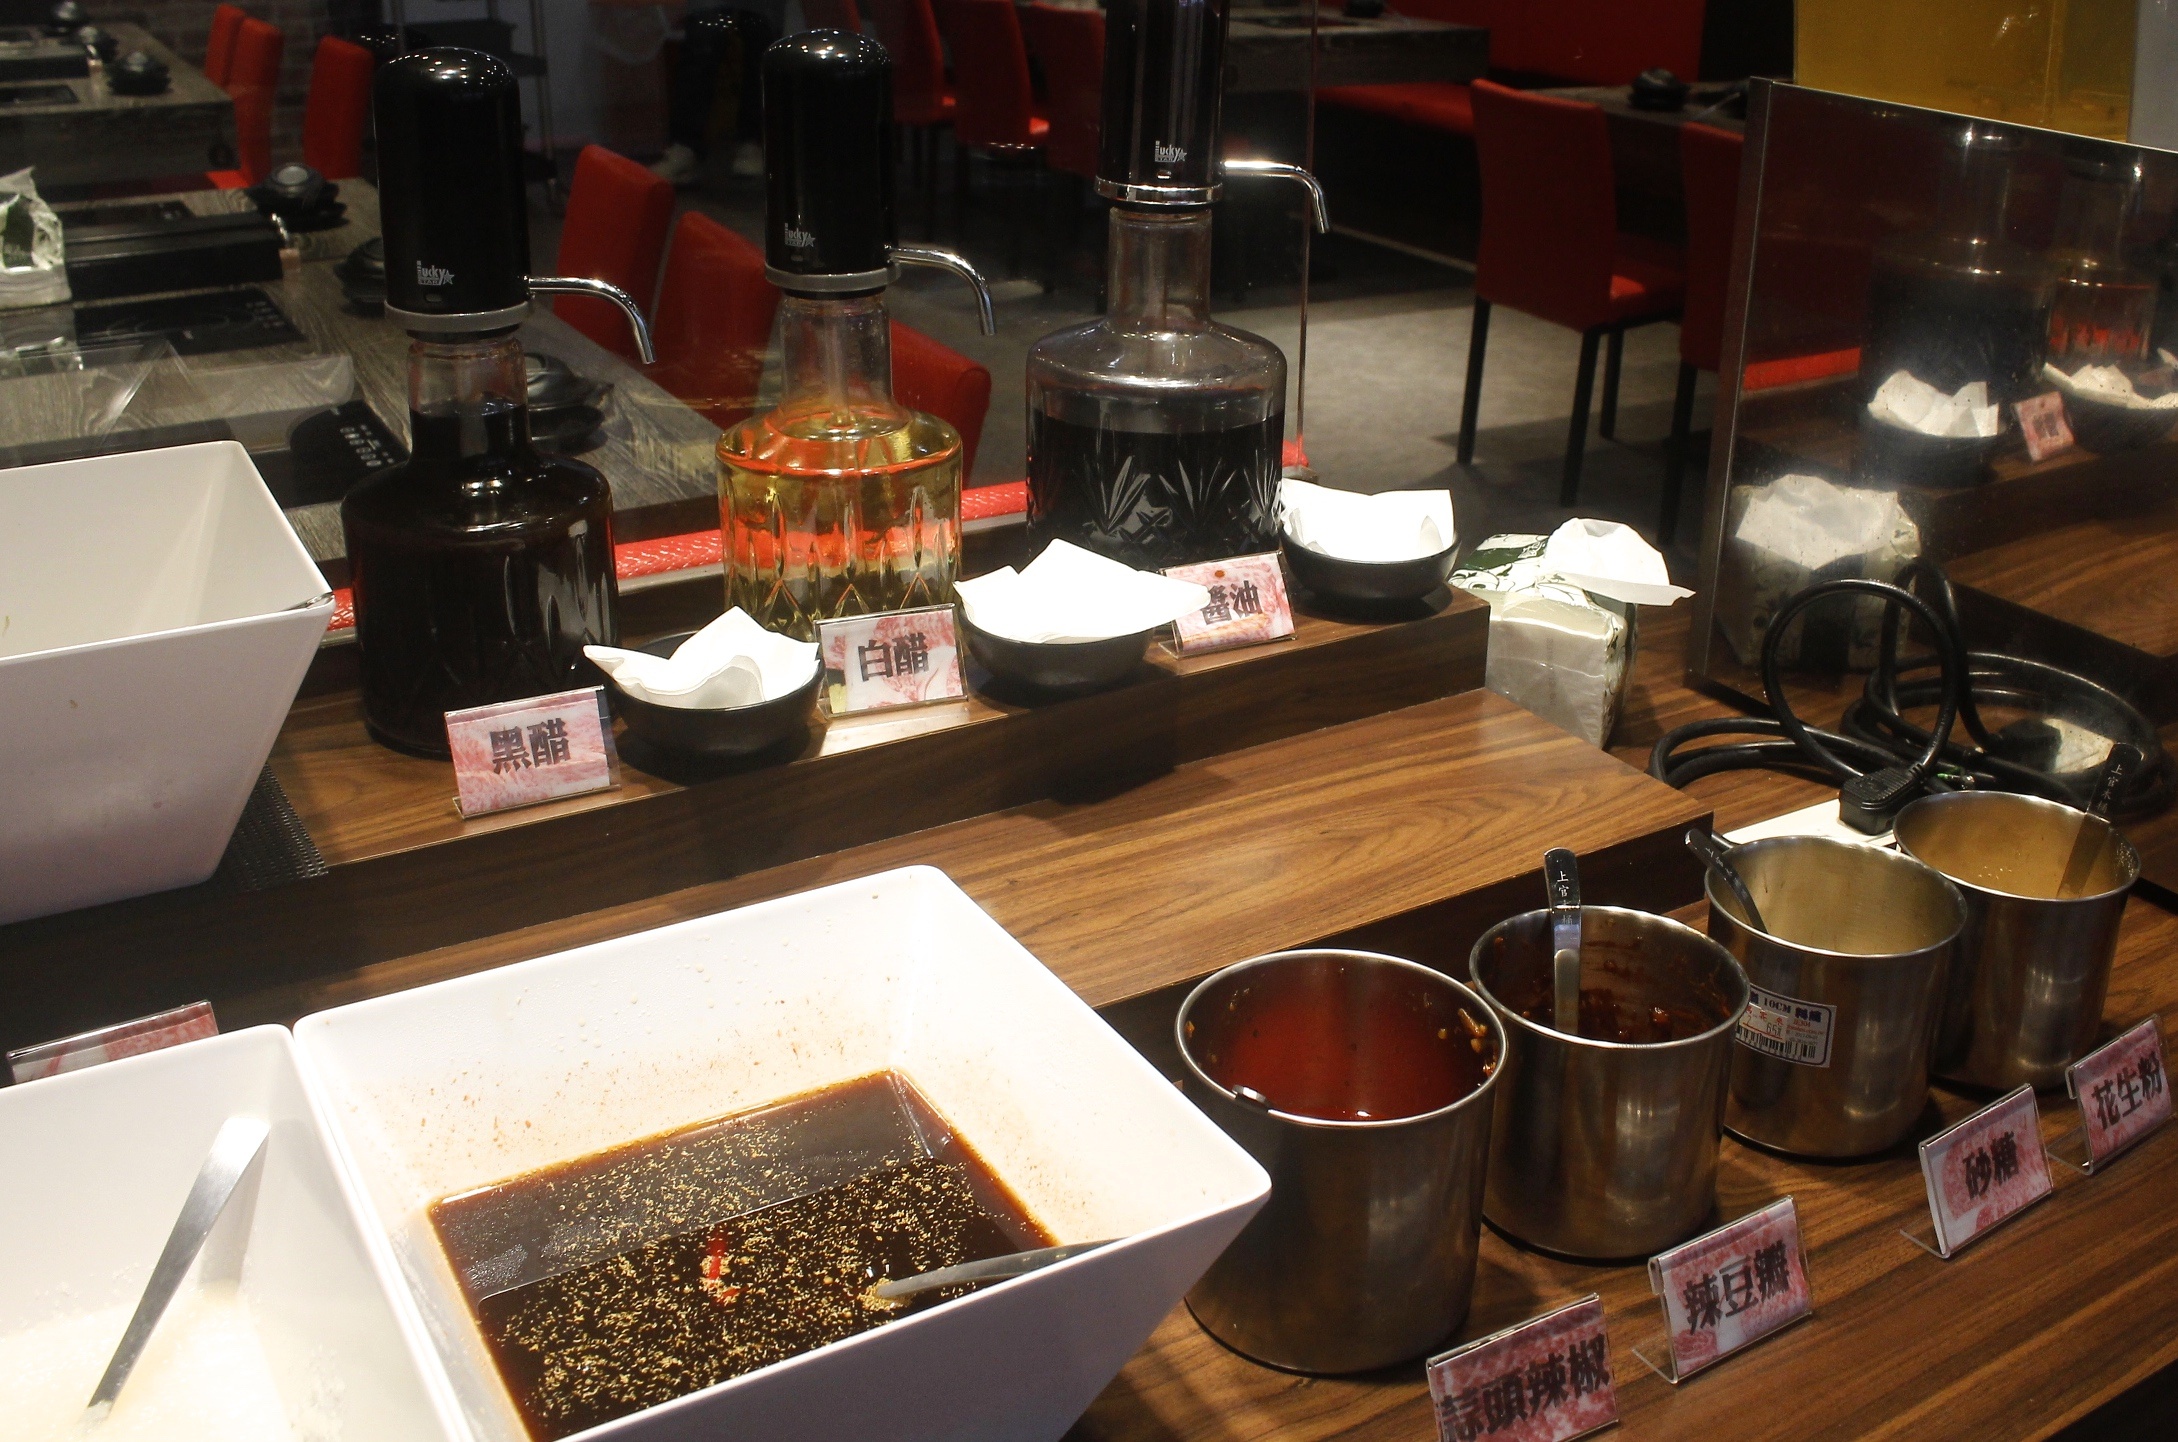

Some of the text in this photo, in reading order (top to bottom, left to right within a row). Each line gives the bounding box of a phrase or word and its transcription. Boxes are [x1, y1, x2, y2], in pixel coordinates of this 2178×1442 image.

[858, 632, 929, 682] 白醋
[490, 717, 571, 774] 黑醋
[2091, 1051, 2162, 1131] 花生粉
[1962, 1131, 2020, 1201] 砂糖
[1683, 1240, 1790, 1335] 辣豆瓣
